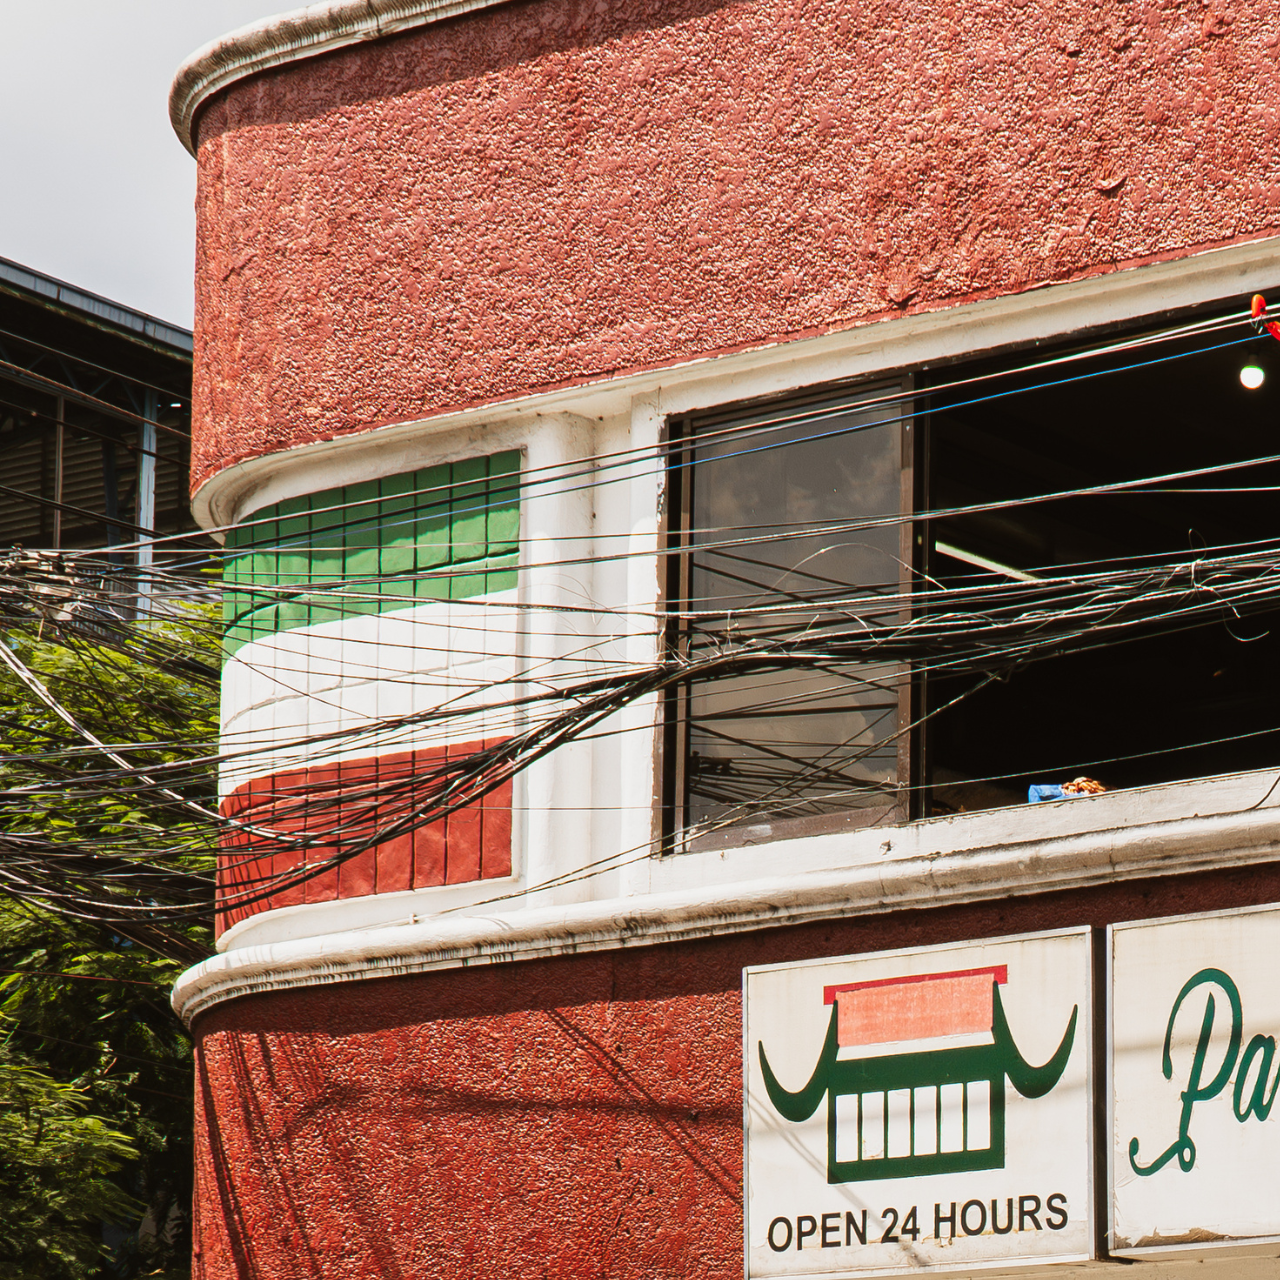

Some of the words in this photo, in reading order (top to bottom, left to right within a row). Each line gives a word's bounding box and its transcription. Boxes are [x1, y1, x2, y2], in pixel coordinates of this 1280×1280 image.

[767, 1209, 869, 1253] OPEN
[880, 1205, 921, 1244] 24
[933, 1192, 1069, 1240] HOURS
